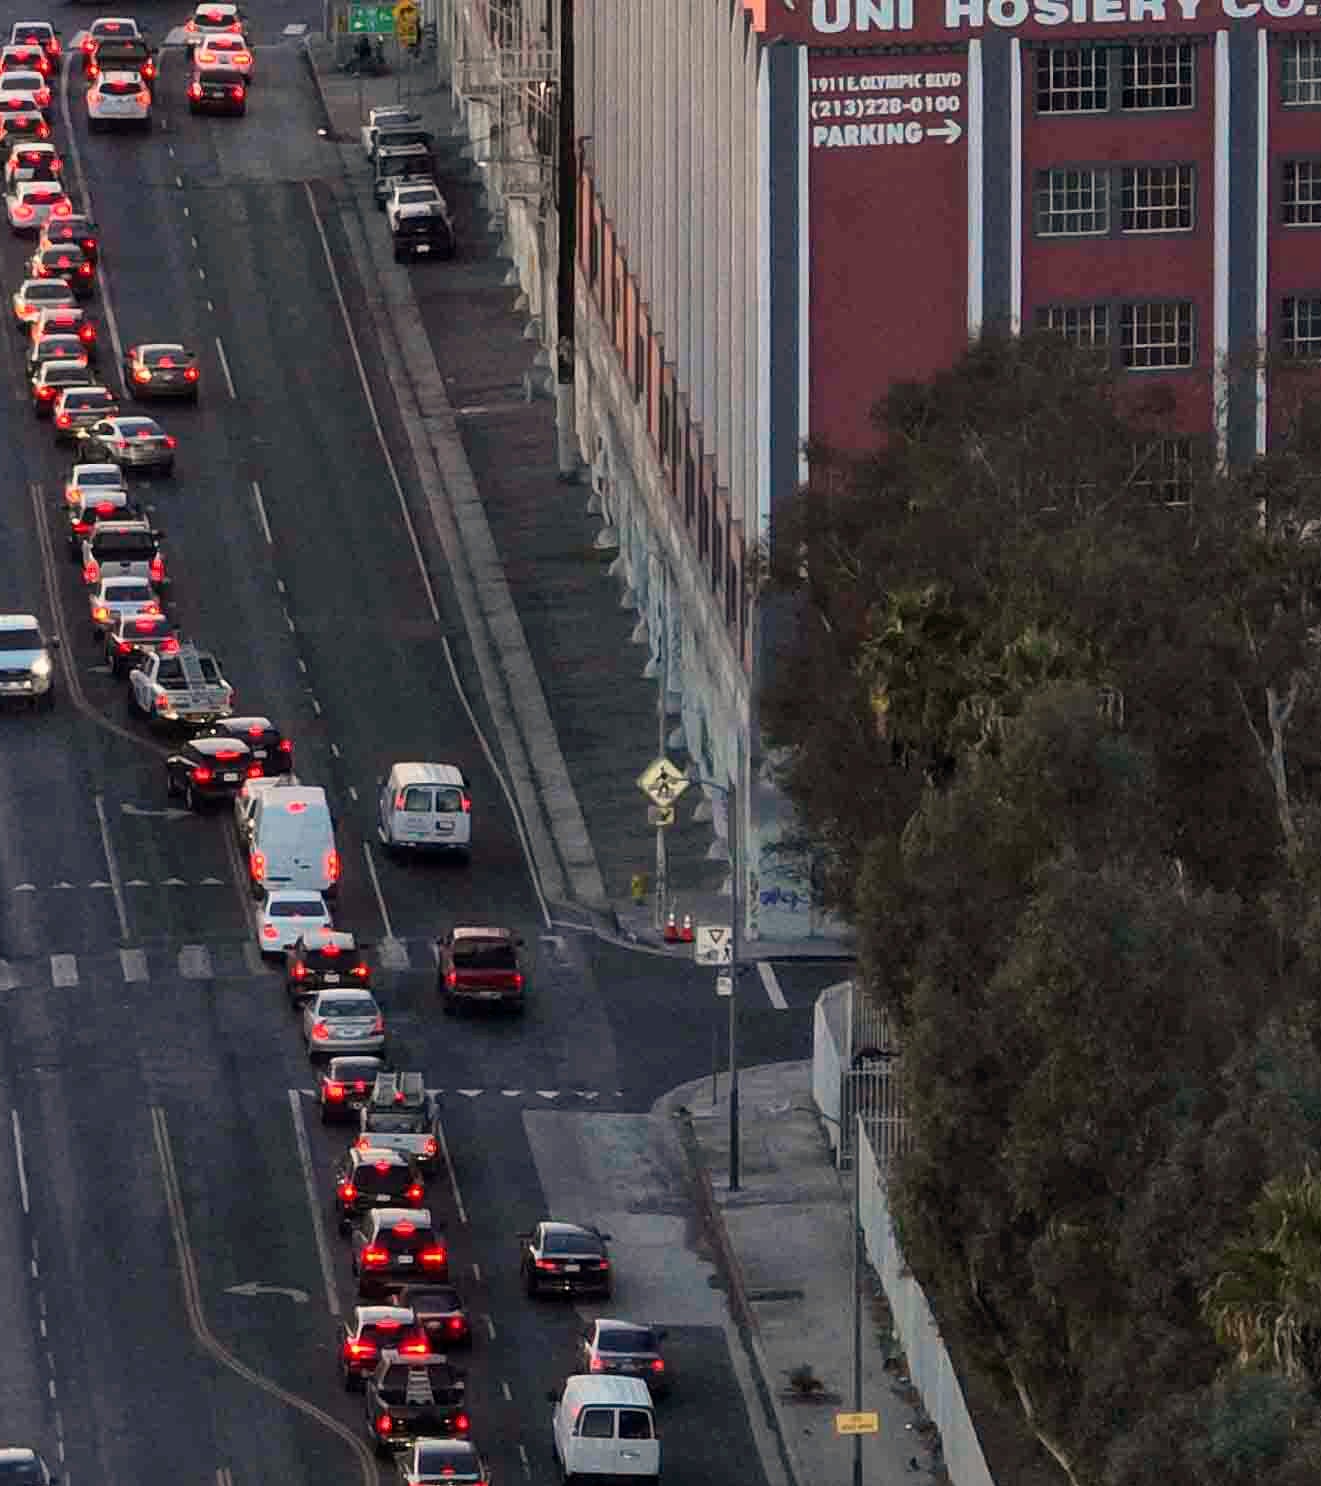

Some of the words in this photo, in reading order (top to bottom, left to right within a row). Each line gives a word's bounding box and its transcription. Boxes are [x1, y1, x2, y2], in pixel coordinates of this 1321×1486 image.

[811, 0, 914, 32] UNI
[944, 0, 1198, 28] HOSIERY
[924, 72, 962, 88] BLVD
[810, 96, 961, 120] (213)228-0100
[813, 121, 923, 148] PARKING
